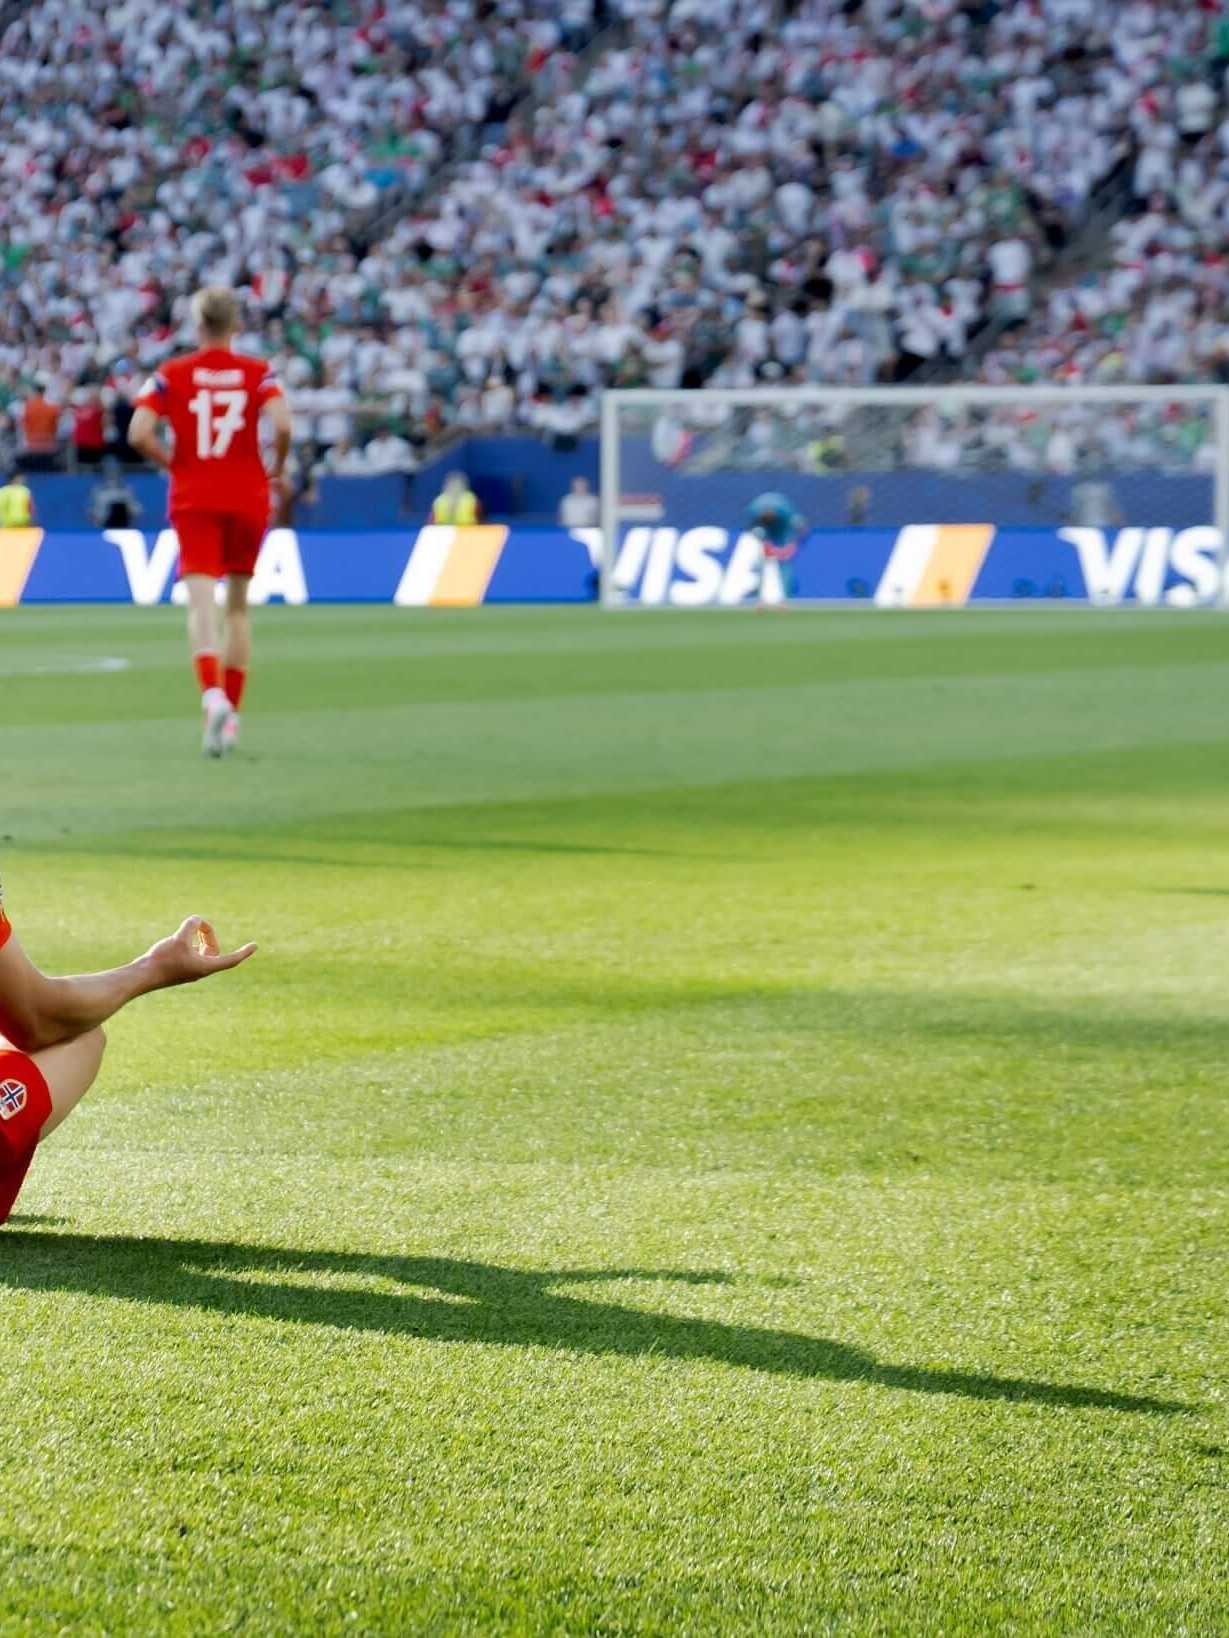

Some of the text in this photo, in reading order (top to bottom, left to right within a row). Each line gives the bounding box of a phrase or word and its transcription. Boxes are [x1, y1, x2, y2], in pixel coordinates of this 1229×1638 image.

[188, 388, 249, 460] 17
[102, 528, 309, 606] VA
[1056, 525, 1229, 607] VIS
